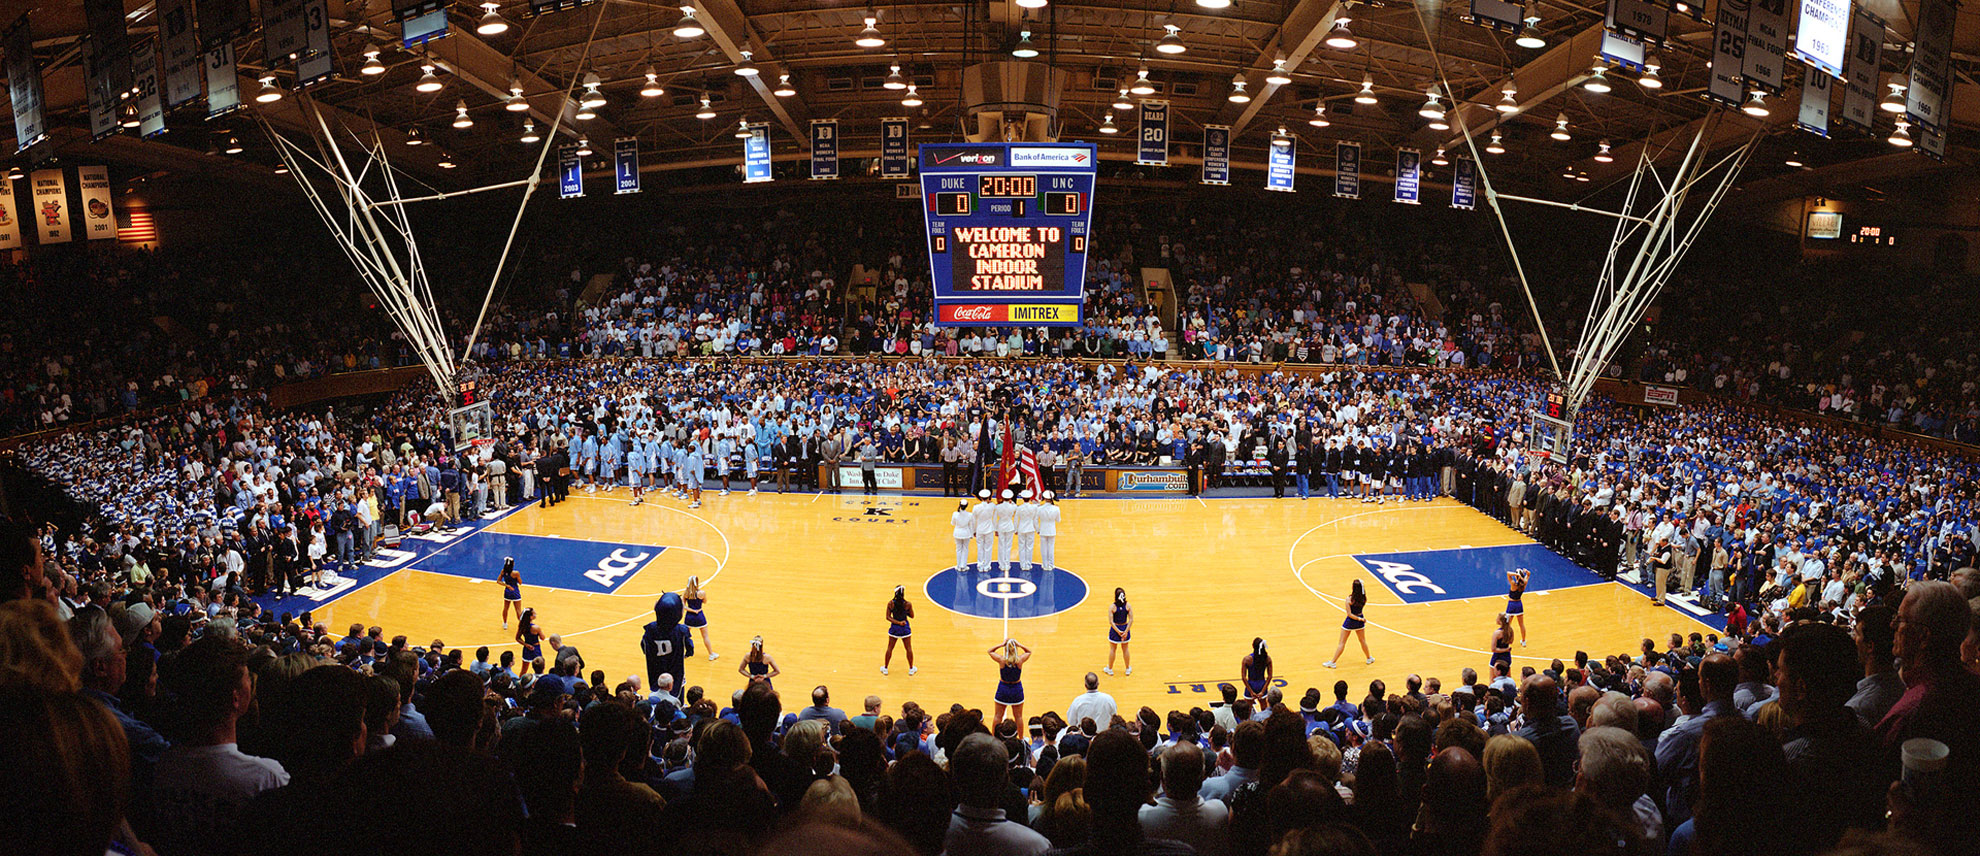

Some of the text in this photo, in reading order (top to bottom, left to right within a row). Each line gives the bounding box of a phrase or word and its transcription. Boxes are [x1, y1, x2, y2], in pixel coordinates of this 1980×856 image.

[1760, 24, 1776, 38] NCAA
[1720, 30, 1744, 58] 25
[1748, 34, 1785, 57] FINAL FOUR
[210, 46, 228, 69] 31
[1144, 112, 1164, 121] BEARD
[1144, 128, 1163, 142] 20
[961, 154, 995, 164] verizon
[568, 168, 574, 181] 1
[624, 162, 631, 176] 1
[564, 184, 578, 192] 2003
[941, 178, 965, 188] DUKE
[981, 177, 1034, 195] 20:00
[1052, 178, 1074, 188] UNC
[957, 195, 968, 213] 0
[1020, 201, 1023, 215] 1
[1066, 195, 1076, 213] 0
[954, 228, 1060, 242] WELCOME TO
[1860, 227, 1880, 236] 20:00
[937, 237, 944, 250] 0
[1075, 237, 1083, 250] 0
[968, 244, 1044, 258] CAMERON
[976, 260, 1038, 274] INDOOR
[971, 275, 1043, 291] STADIUM
[1014, 307, 1059, 319] IMITREX
[463, 391, 474, 405] 35
[1648, 389, 1675, 399] ESPN
[1548, 403, 1559, 417] 35
[584, 548, 650, 588] ACC
[1366, 559, 1446, 594] ACC
[654, 640, 672, 656] D
